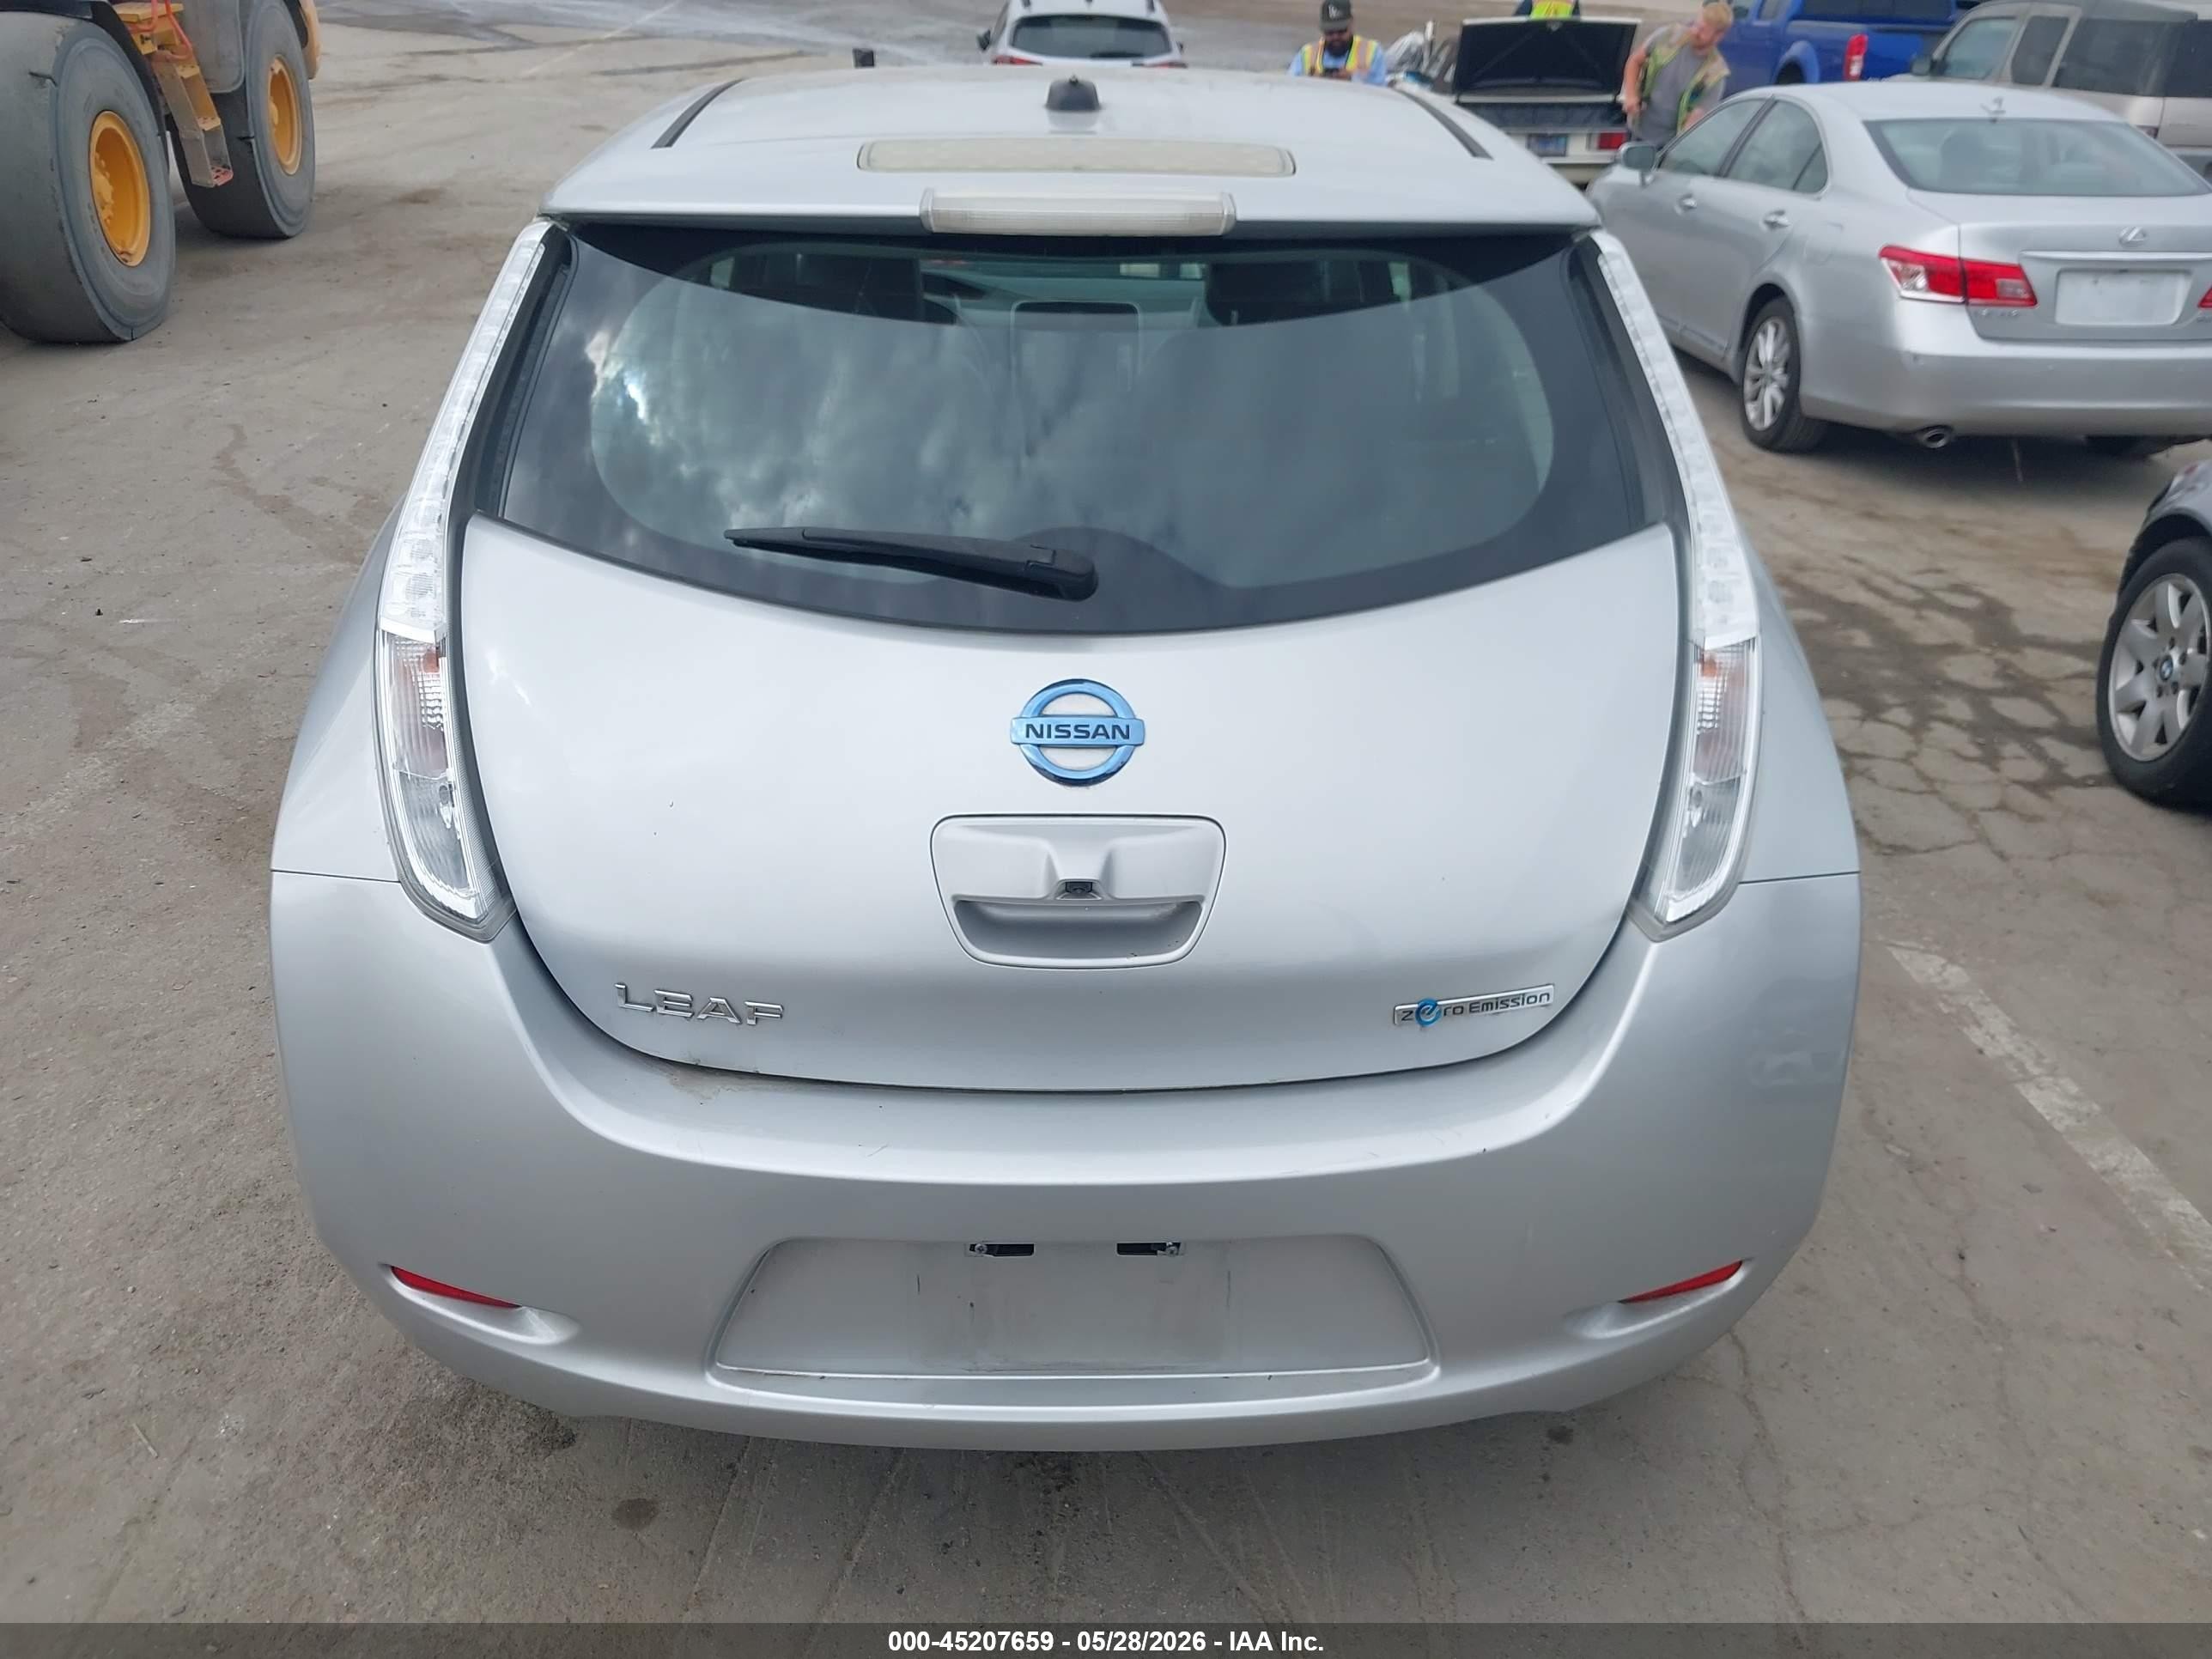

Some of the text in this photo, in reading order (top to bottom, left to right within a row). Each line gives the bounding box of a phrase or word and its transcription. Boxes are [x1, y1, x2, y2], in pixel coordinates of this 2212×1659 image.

[1025, 723, 1130, 740] NISSAN
[614, 982, 784, 1025] LEAF
[1468, 992, 1551, 1013] Emission
